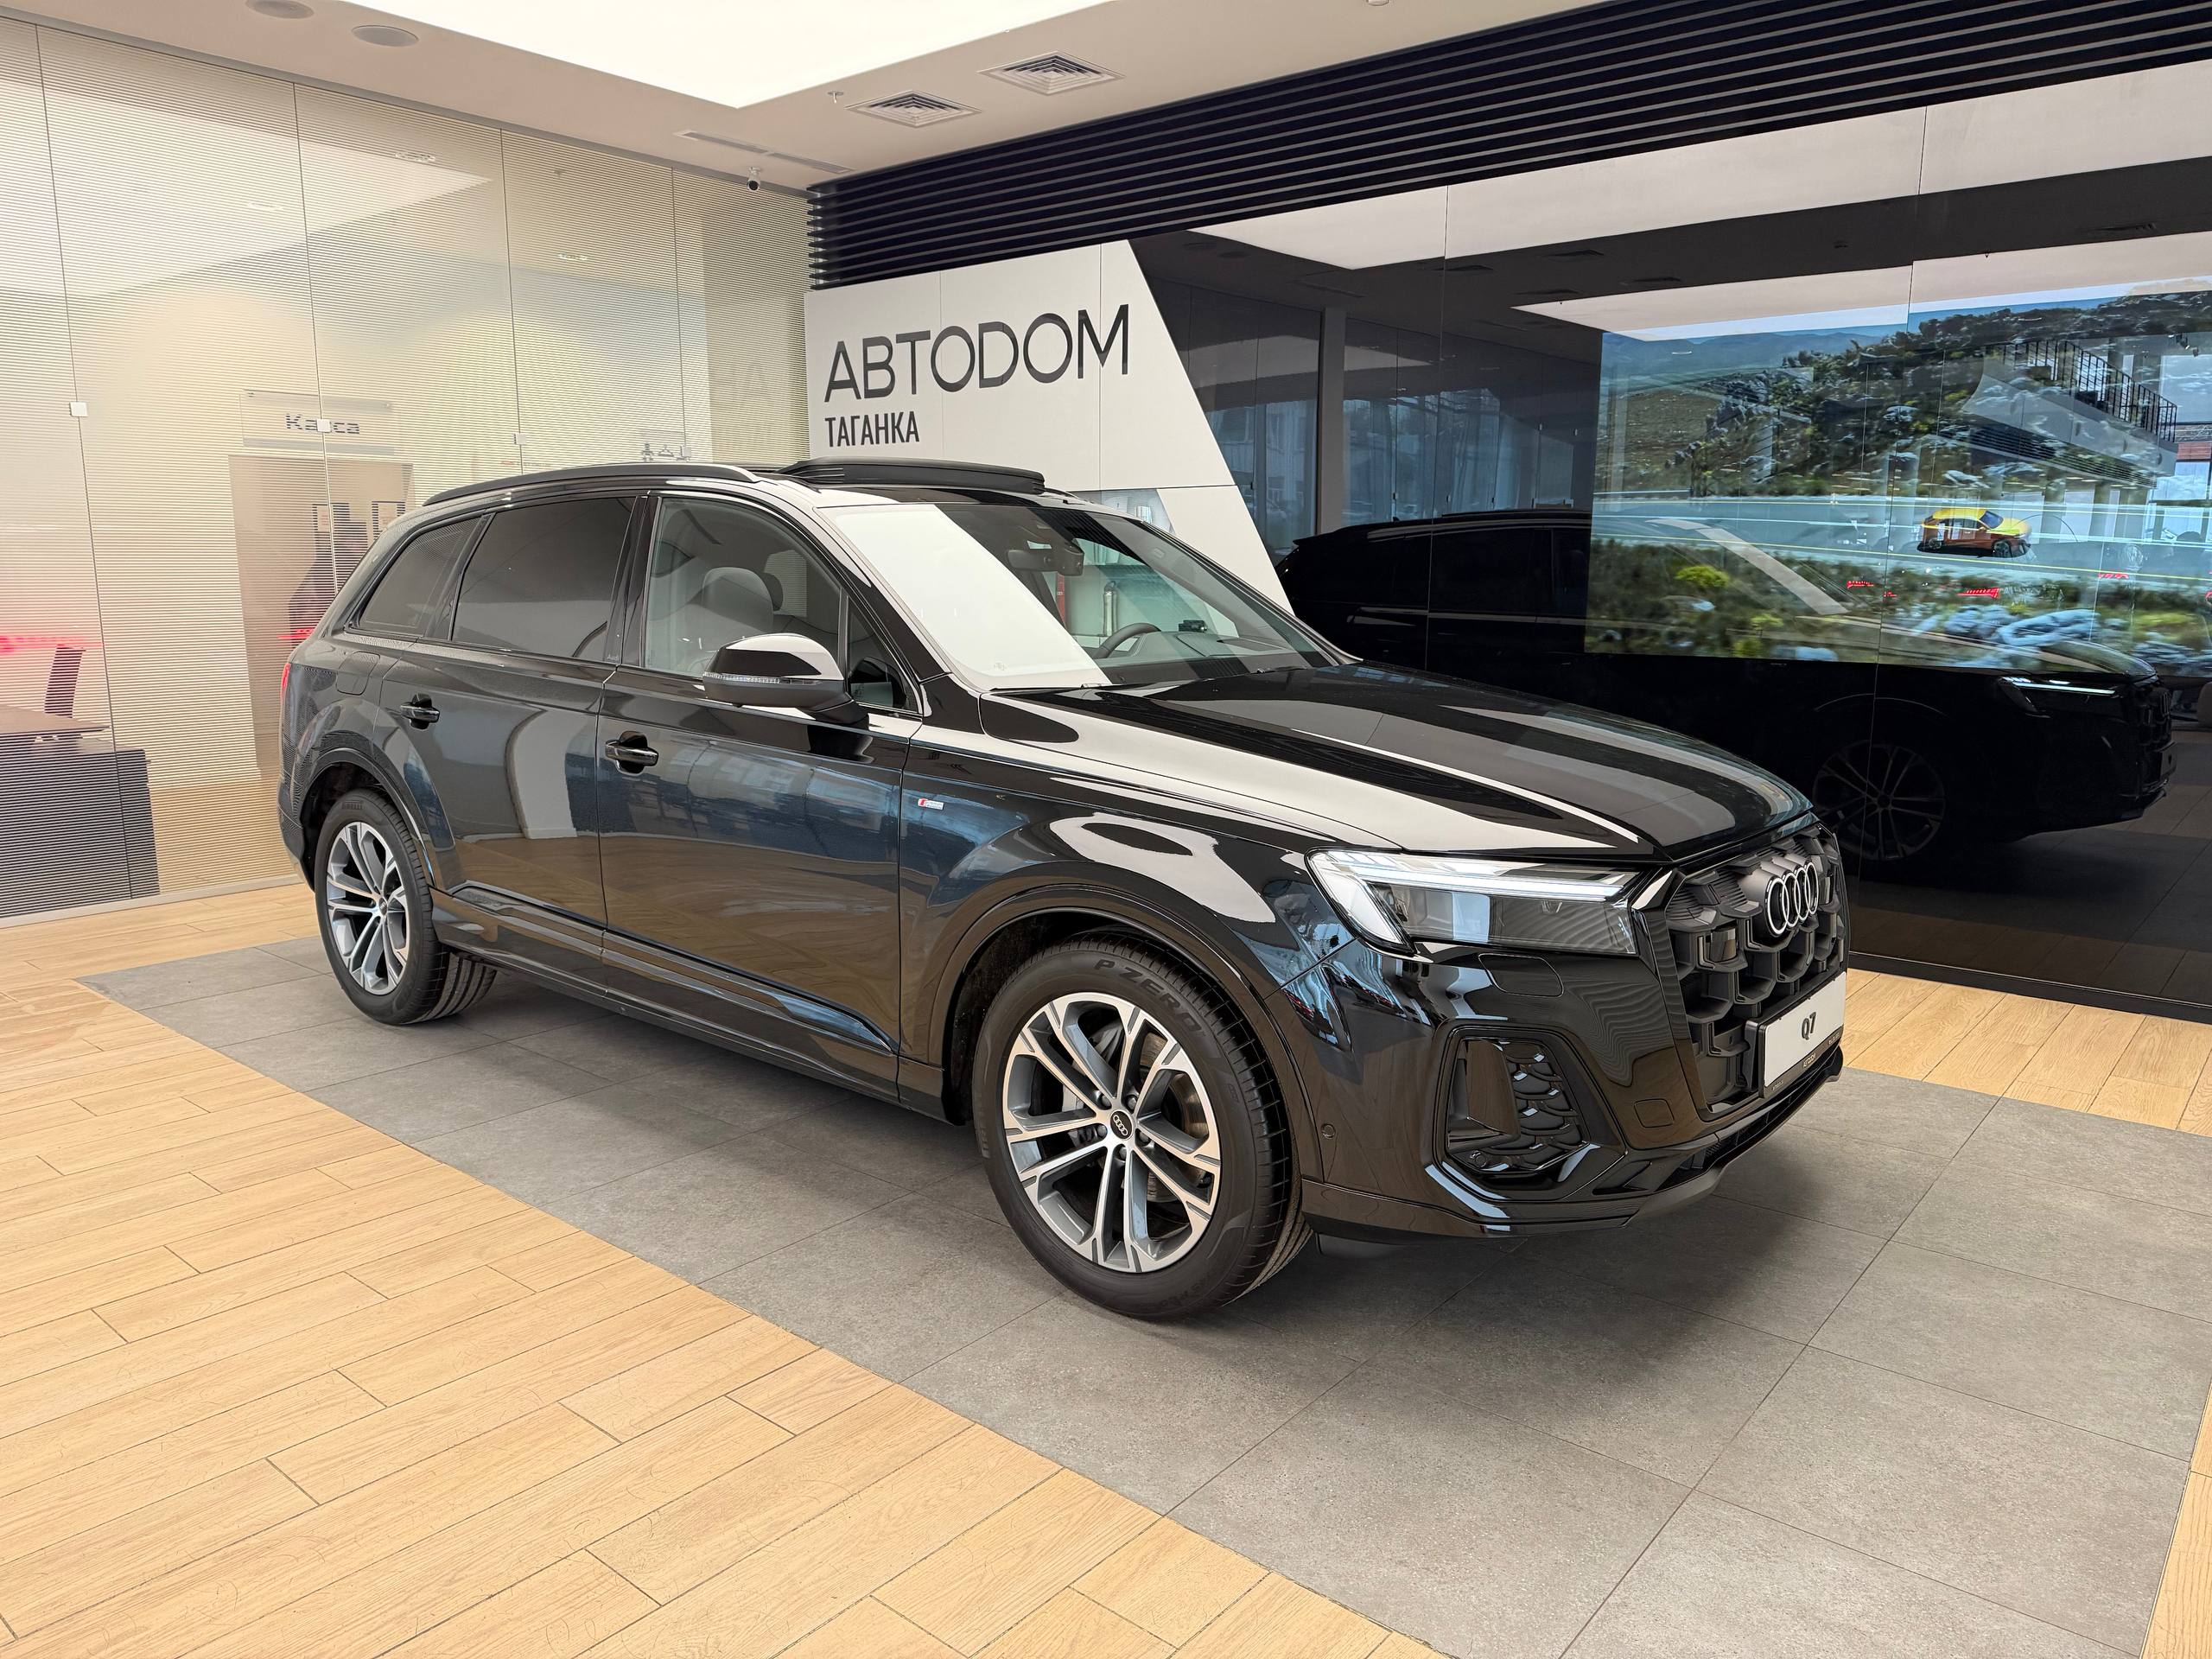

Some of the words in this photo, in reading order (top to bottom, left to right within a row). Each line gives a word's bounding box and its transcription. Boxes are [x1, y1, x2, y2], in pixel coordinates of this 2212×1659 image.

[285, 414, 360, 435] Каса
[824, 410, 920, 448] ТАГАНКА
[1094, 959, 1116, 969] P
[1119, 966, 1203, 1033] ZERO
[1801, 1012, 1816, 1040] Q7
